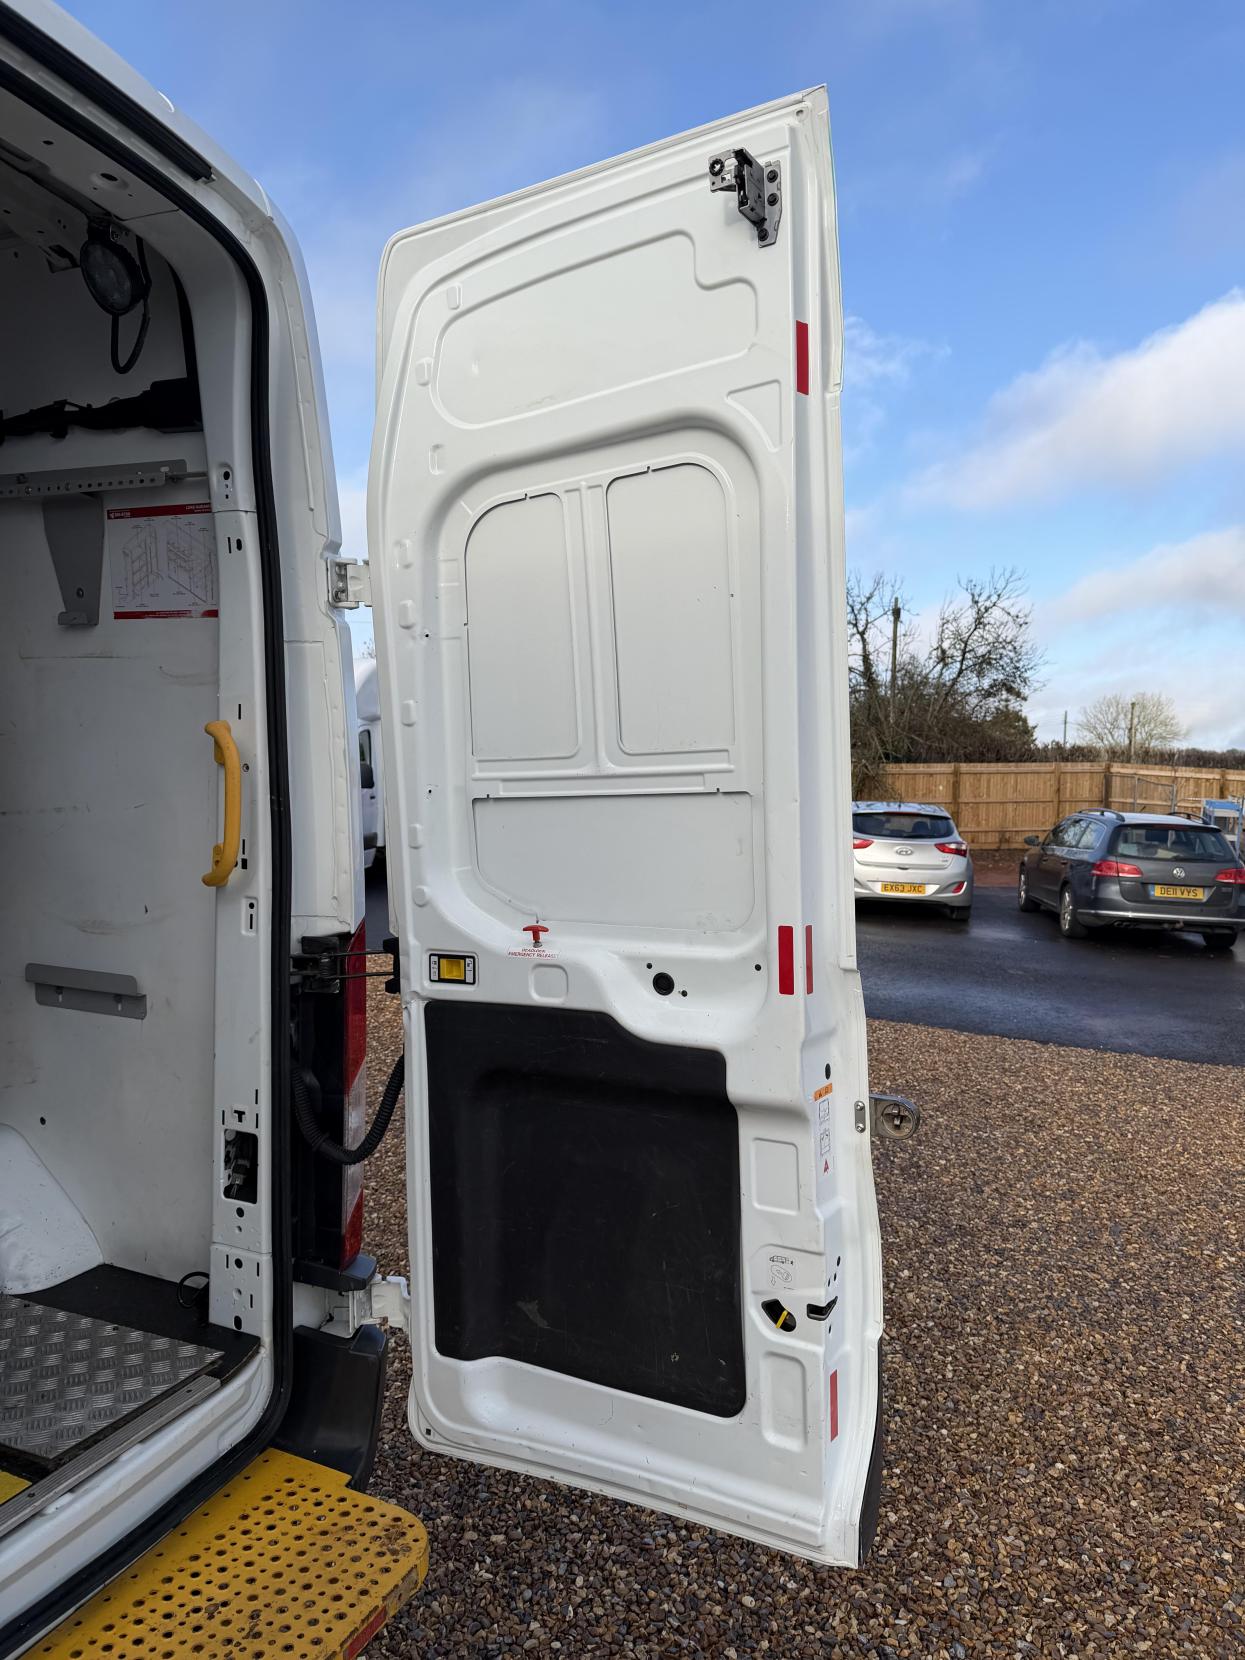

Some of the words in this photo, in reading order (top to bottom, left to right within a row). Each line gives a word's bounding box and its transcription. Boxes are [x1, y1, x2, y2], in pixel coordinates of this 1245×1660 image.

[883, 883, 905, 892] EX63
[907, 884, 923, 893] JXC
[1160, 886, 1178, 896] DE11
[1180, 887, 1198, 898] VYS
